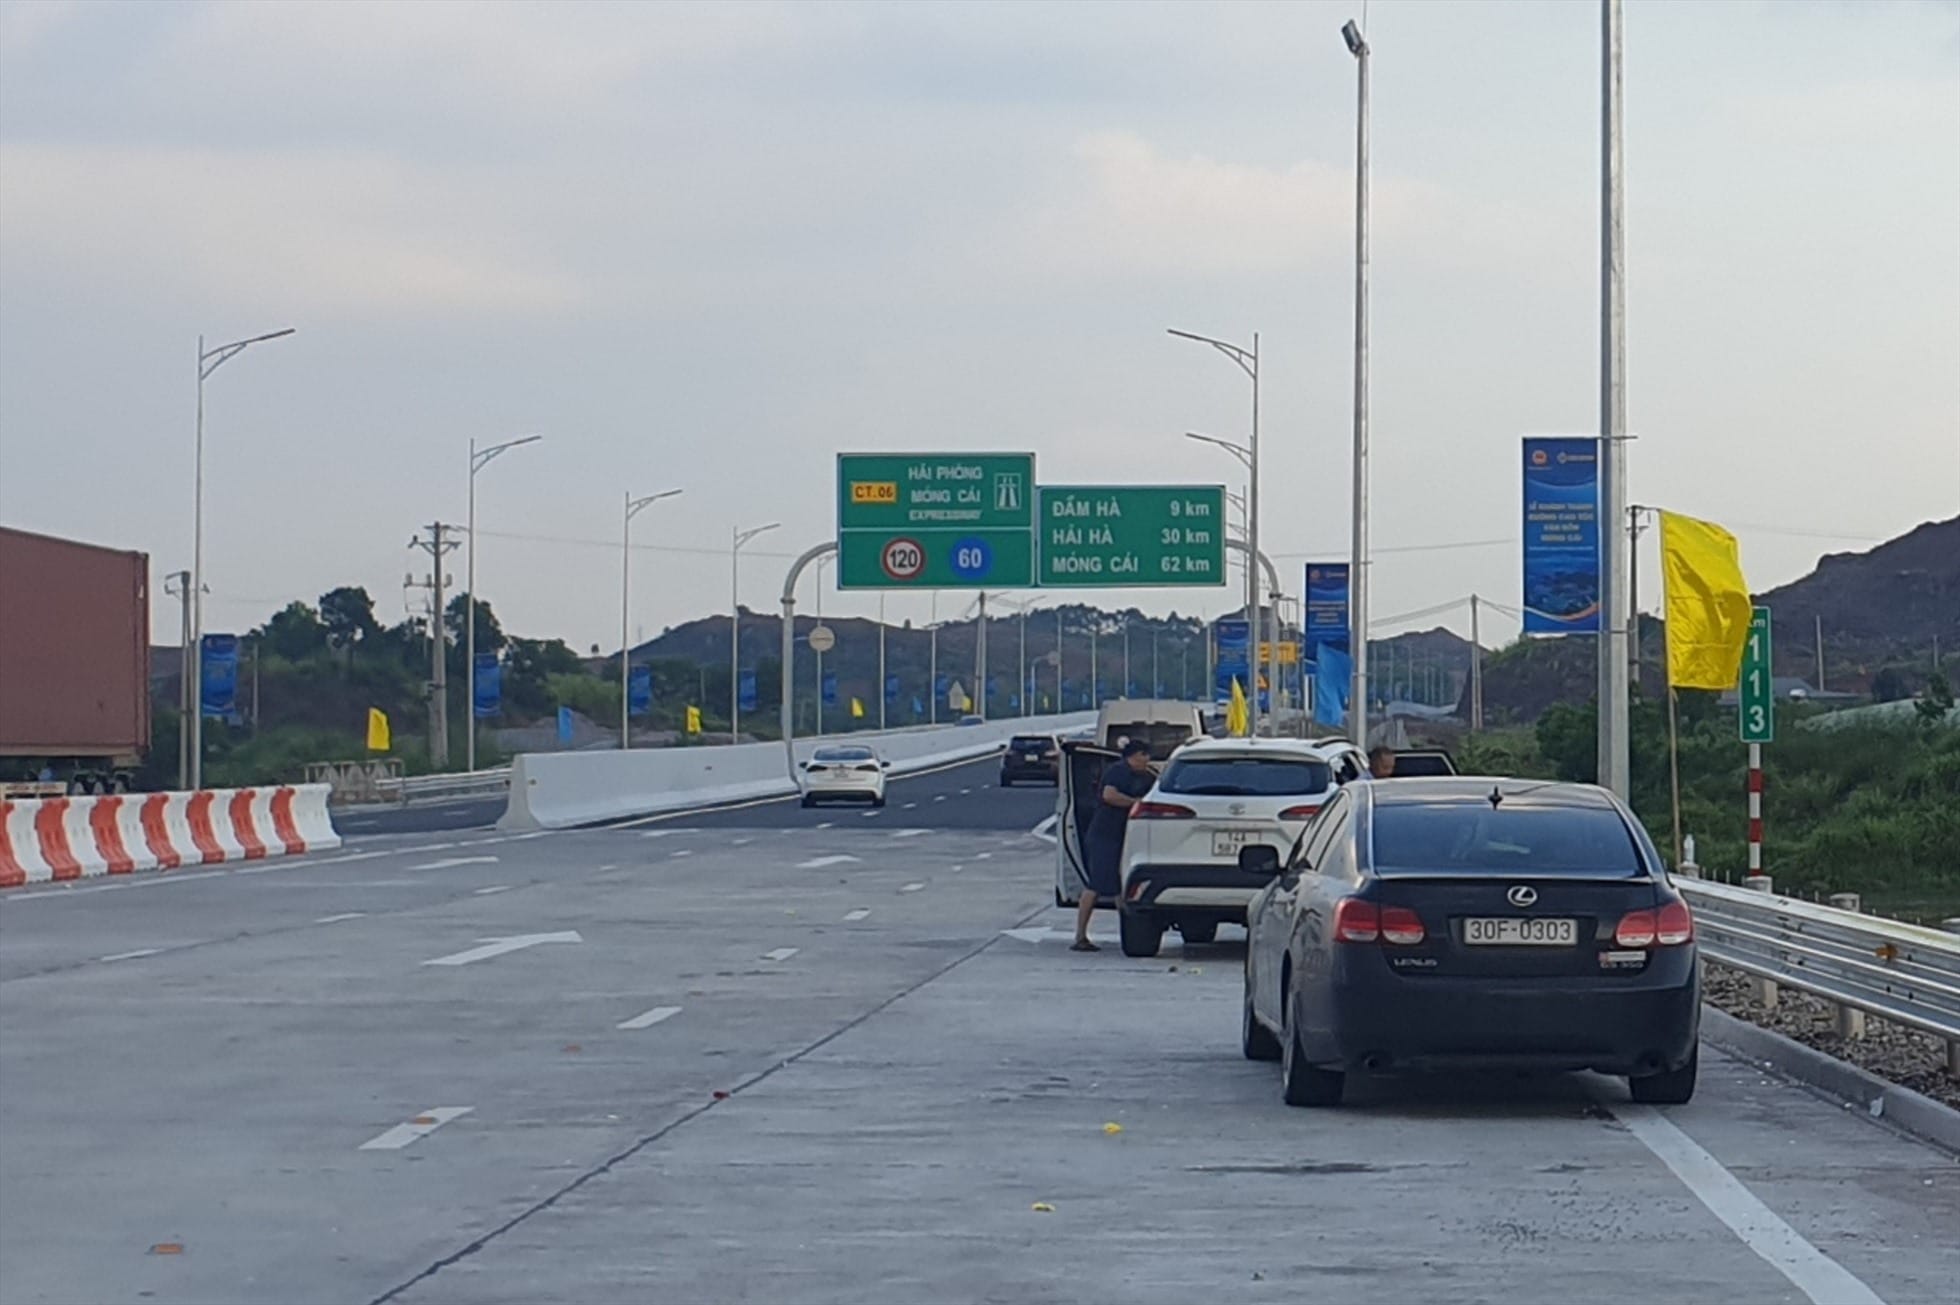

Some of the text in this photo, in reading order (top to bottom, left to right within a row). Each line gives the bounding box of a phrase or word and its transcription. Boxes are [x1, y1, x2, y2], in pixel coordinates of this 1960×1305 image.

[855, 485, 893, 499] CT.06
[911, 485, 981, 503] MÓNG CÁI
[1096, 496, 1121, 517] HÀ
[1170, 500, 1180, 517] 9
[1185, 501, 1210, 517] km
[1089, 524, 1114, 545] HÀ
[1161, 528, 1180, 545] 30
[1185, 528, 1210, 545] km
[889, 549, 919, 569] 120
[957, 547, 982, 568] 60
[1052, 551, 1210, 573] MÓNG CÁI 62 km
[1470, 919, 1572, 941] 30F-0303
